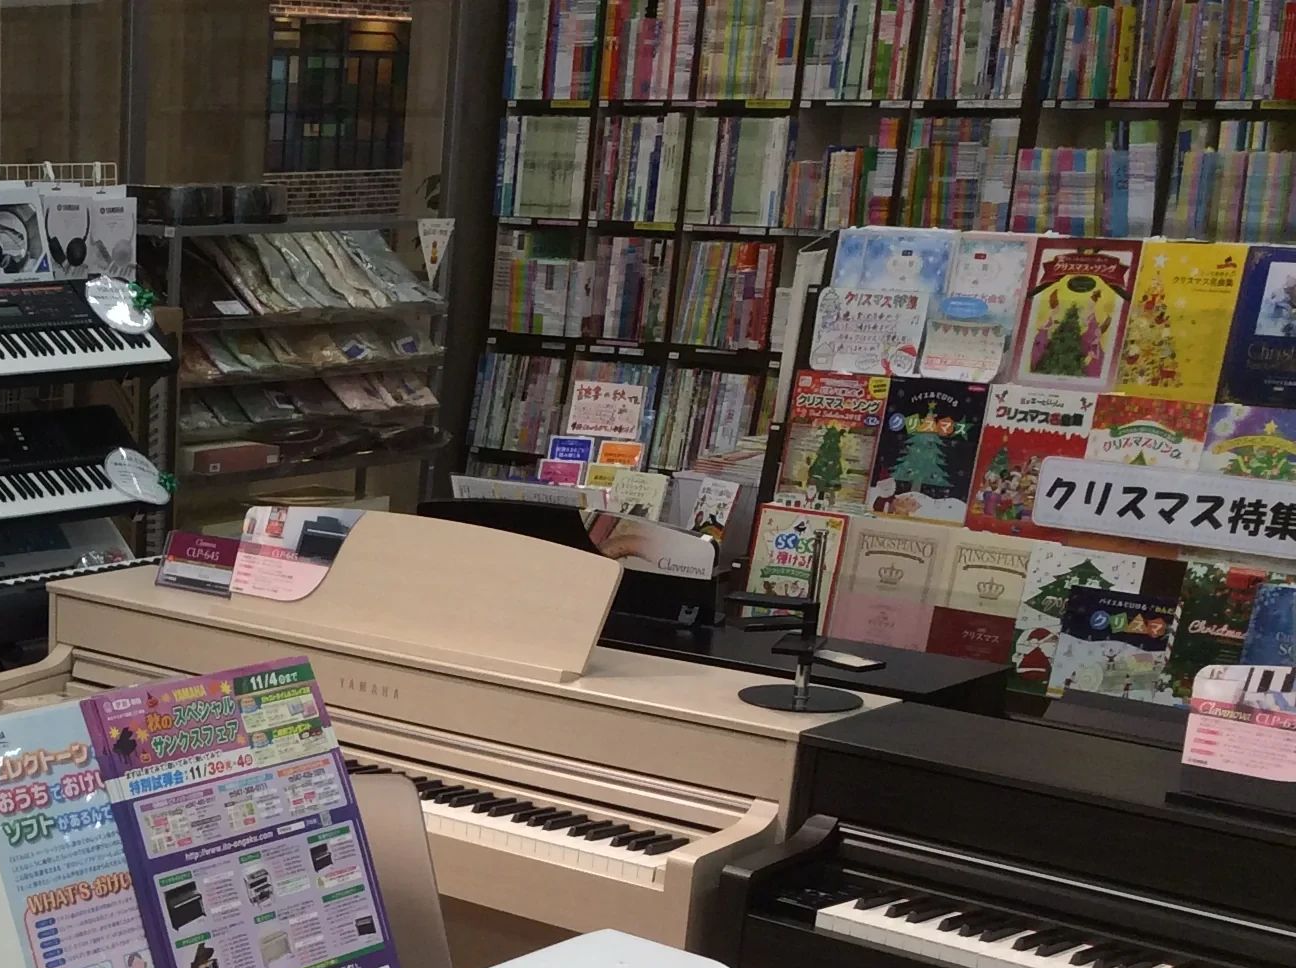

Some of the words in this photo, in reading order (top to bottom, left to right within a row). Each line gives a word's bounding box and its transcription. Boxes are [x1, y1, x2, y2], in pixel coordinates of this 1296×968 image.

[890, 413, 967, 436] クリスマス
[1046, 475, 1296, 542] クリスマス特集
[1091, 612, 1164, 637] クリスマ
[339, 678, 399, 700] YAMAHA
[146, 695, 236, 733] 秋のスペシャル
[1199, 701, 1252, 723] Clavinova
[150, 719, 239, 759] サンクスフェア
